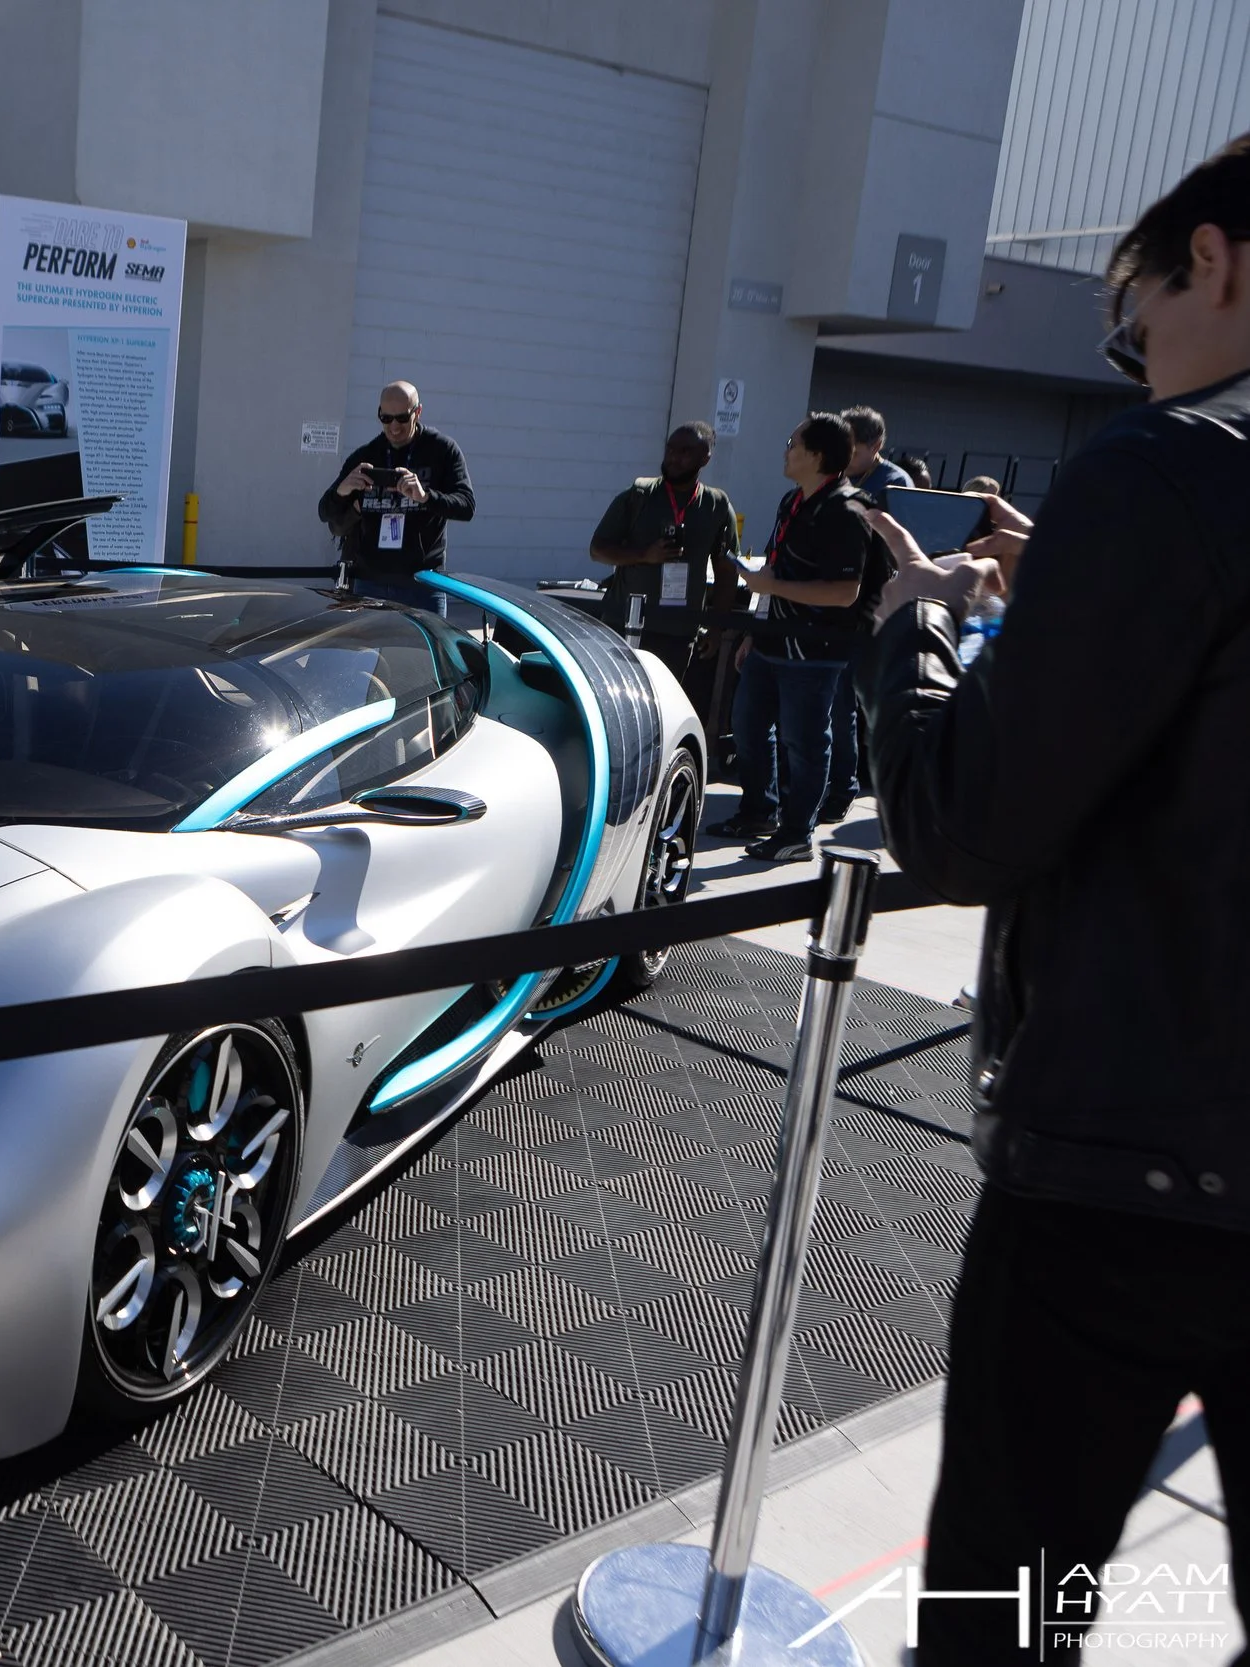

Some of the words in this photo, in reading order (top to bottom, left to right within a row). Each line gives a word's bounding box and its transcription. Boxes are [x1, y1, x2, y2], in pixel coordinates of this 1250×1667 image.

[53, 216, 101, 250] DARE
[103, 224, 125, 252] TO
[23, 242, 118, 280] PERFORM
[124, 262, 166, 280] SEMA
[908, 251, 932, 271] Door
[16, 281, 33, 292] THE
[35, 283, 74, 296] ULTIMATE
[76, 286, 123, 301] HYDROGEN
[124, 293, 158, 306] ELECTRIC
[913, 272, 923, 305] 1
[16, 293, 60, 306] SUPERCAR
[62, 298, 107, 311] PRESENTED
[109, 303, 120, 313] BY
[122, 305, 164, 318] HYPERION
